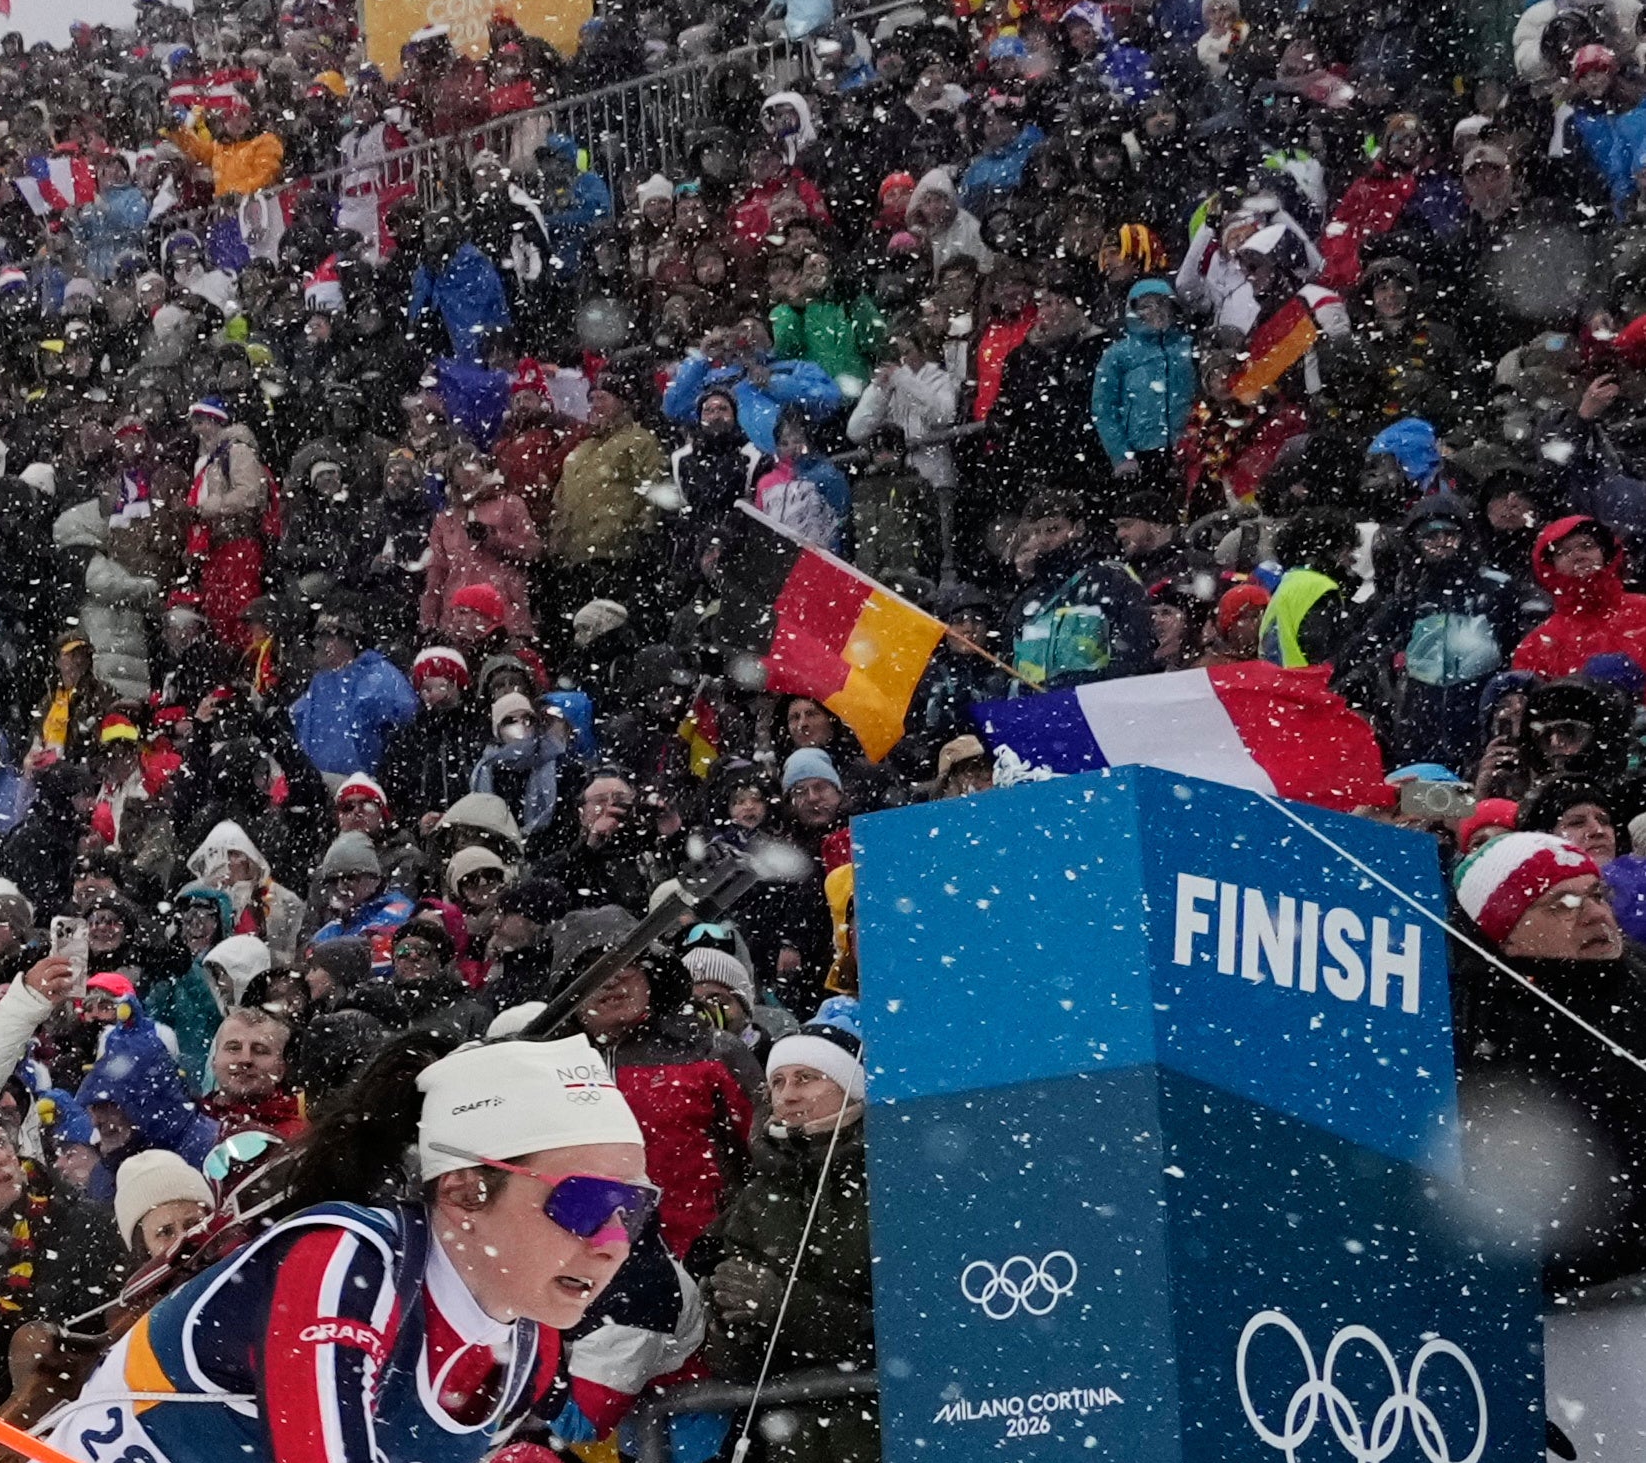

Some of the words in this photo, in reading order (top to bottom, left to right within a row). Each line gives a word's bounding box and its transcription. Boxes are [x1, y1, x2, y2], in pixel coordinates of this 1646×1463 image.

[1172, 872, 1422, 1015] FINISH
[451, 1099, 492, 1116] CRAFT
[299, 1323, 382, 1354] CRAFT
[933, 1396, 1024, 1424] MILANO
[1027, 1386, 1125, 1413] CORTINA
[1005, 1416, 1052, 1437] 2026
